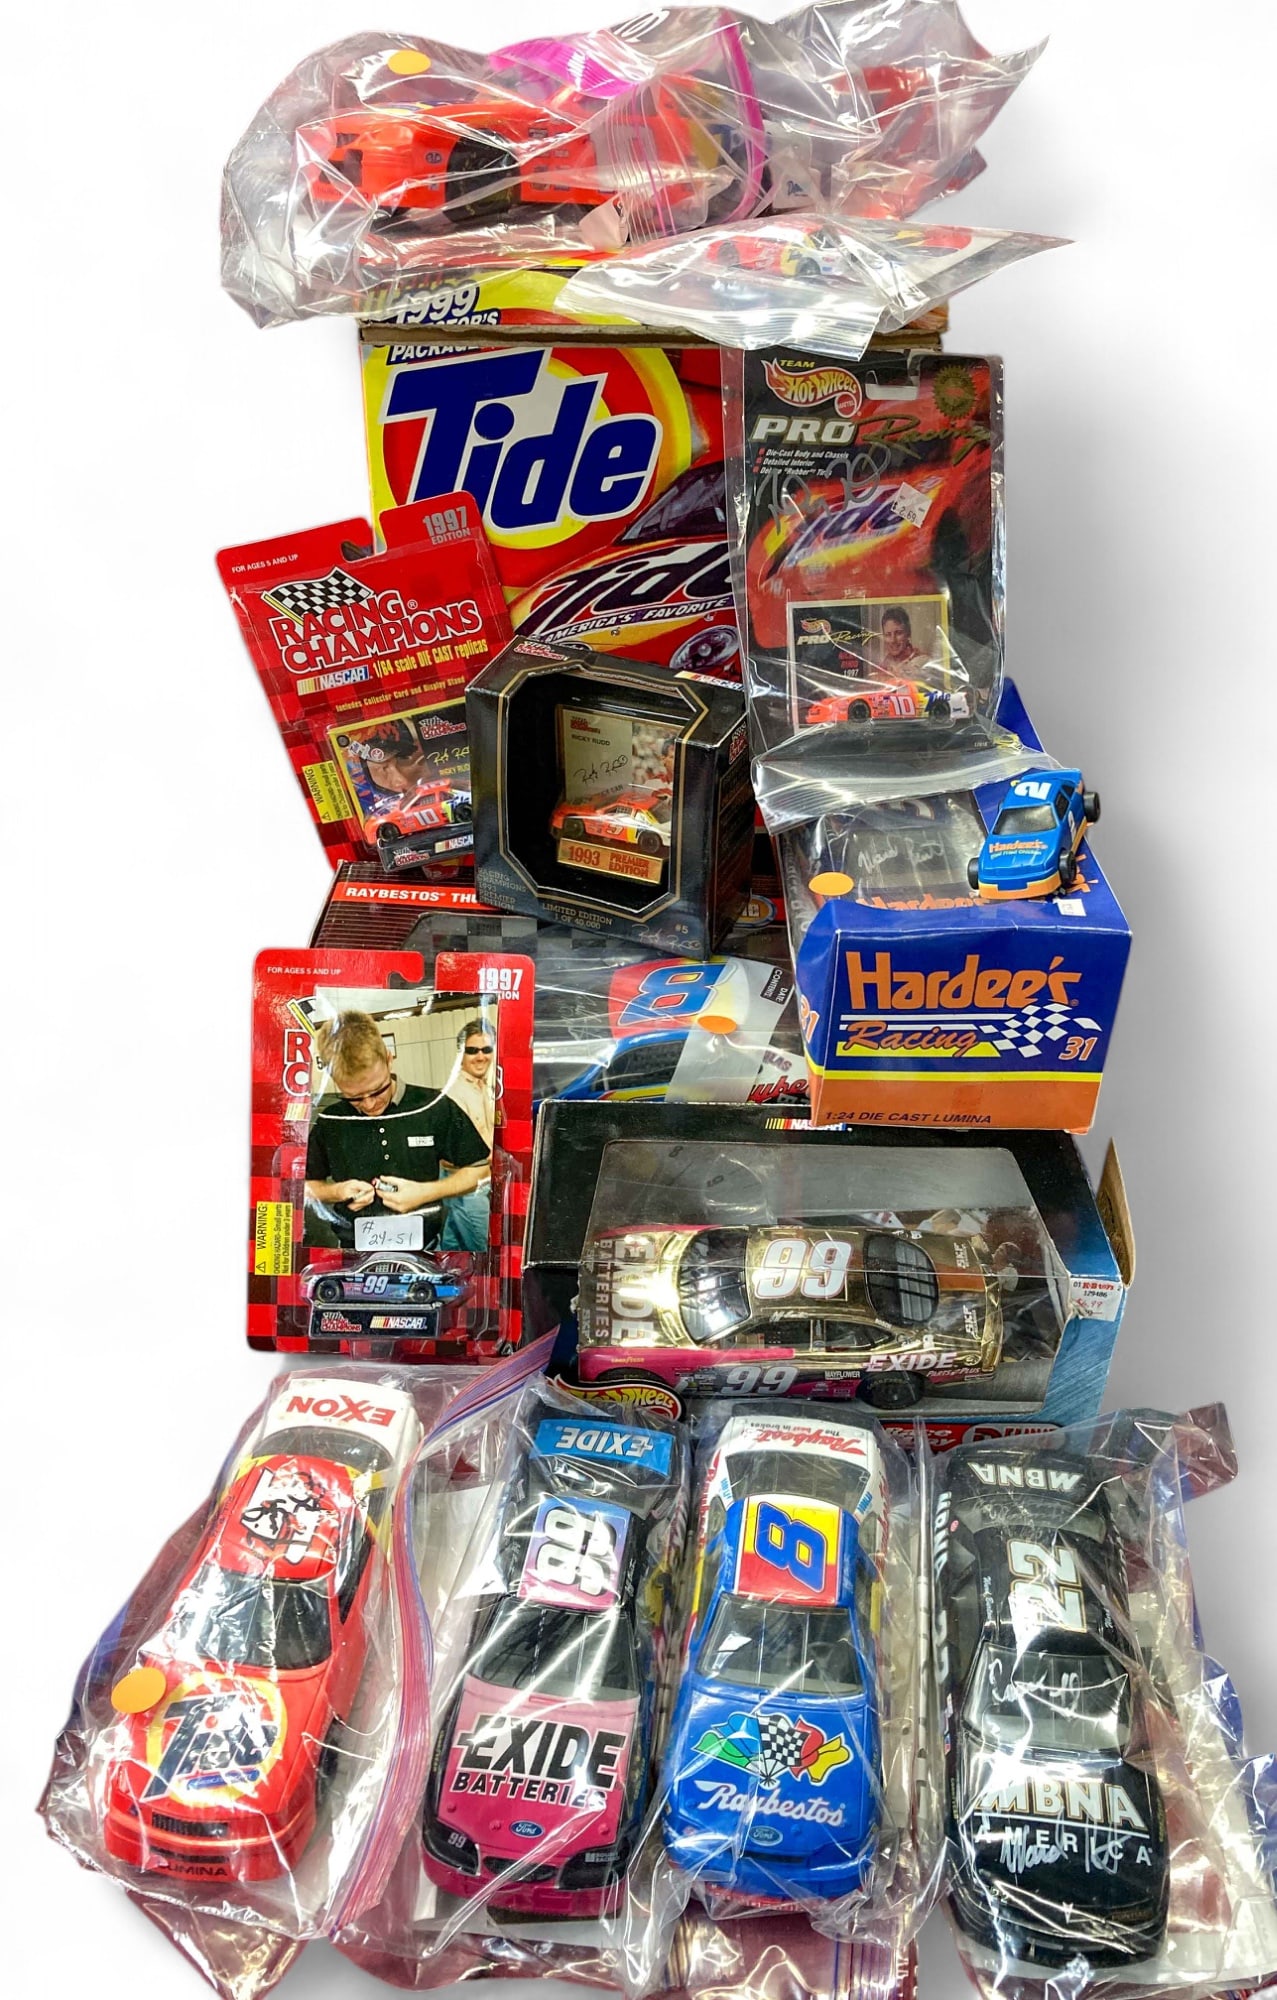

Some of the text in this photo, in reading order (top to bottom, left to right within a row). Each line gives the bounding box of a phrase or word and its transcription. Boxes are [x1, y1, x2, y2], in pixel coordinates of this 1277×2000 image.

[779, 359, 814, 368] TEAM
[386, 349, 656, 529] Tide
[752, 414, 991, 467] PRO Racing
[763, 458, 815, 467] Detailed Interior
[765, 449, 793, 457] Die-Cast
[795, 450, 810, 459] Body
[422, 505, 468, 537] 1997
[431, 527, 471, 545] EDITION
[232, 554, 298, 574] FOR AGES 5 AND UP
[272, 591, 403, 649] RACING
[644, 597, 730, 620] FAVORITE
[284, 600, 483, 674] CHAMPIONS
[797, 635, 829, 645] PRO
[318, 639, 489, 690] NASCAR 1/64 scale DIE CAST replicas
[363, 691, 393, 708] Collector
[890, 696, 916, 716] 10
[414, 808, 439, 826] 10
[449, 834, 473, 850] NASCA
[567, 846, 601, 866] 1993
[610, 853, 650, 868] PREMIER
[608, 861, 650, 879] EDITION
[346, 887, 440, 902] RAYBESTOS
[478, 882, 498, 893] 1993
[542, 903, 613, 926] LIMITED EDITION
[675, 924, 689, 935] #5
[267, 966, 283, 974] FOR
[284, 966, 306, 975] AGES
[306, 967, 311, 975] 5
[313, 967, 332, 975] AND
[477, 967, 523, 991] 1997
[846, 952, 1082, 1009] Hardee's
[845, 1020, 980, 1058] Racing
[1058, 1036, 1097, 1061] 31
[825, 1111, 991, 1124] 1:24 DIE CAST LUMINA
[362, 1221, 374, 1232] #
[953, 1242, 968, 1269] SKF
[754, 1238, 851, 1299] 99
[363, 1275, 388, 1295] 99
[595, 1240, 613, 1338] BATTERIES
[388, 1317, 426, 1329] NASCAR
[964, 1305, 978, 1339] SKF
[862, 1352, 957, 1372] EXIDE
[721, 1366, 799, 1395] 99
[825, 1371, 861, 1379] MAYFLOWER
[286, 1395, 397, 1427] EXXON
[555, 1427, 654, 1458] EXIDE
[750, 1428, 867, 1456] Raybest
[967, 1462, 1084, 1491] MBNA
[755, 1501, 827, 1593] 8
[1006, 1538, 1088, 1634] 22
[457, 1715, 626, 1790] EXIDE
[694, 1780, 845, 1826] Raybestos
[974, 1780, 1148, 1832] MBNA
[447, 1832, 467, 1848] 99
[514, 1824, 538, 1836] Ford
